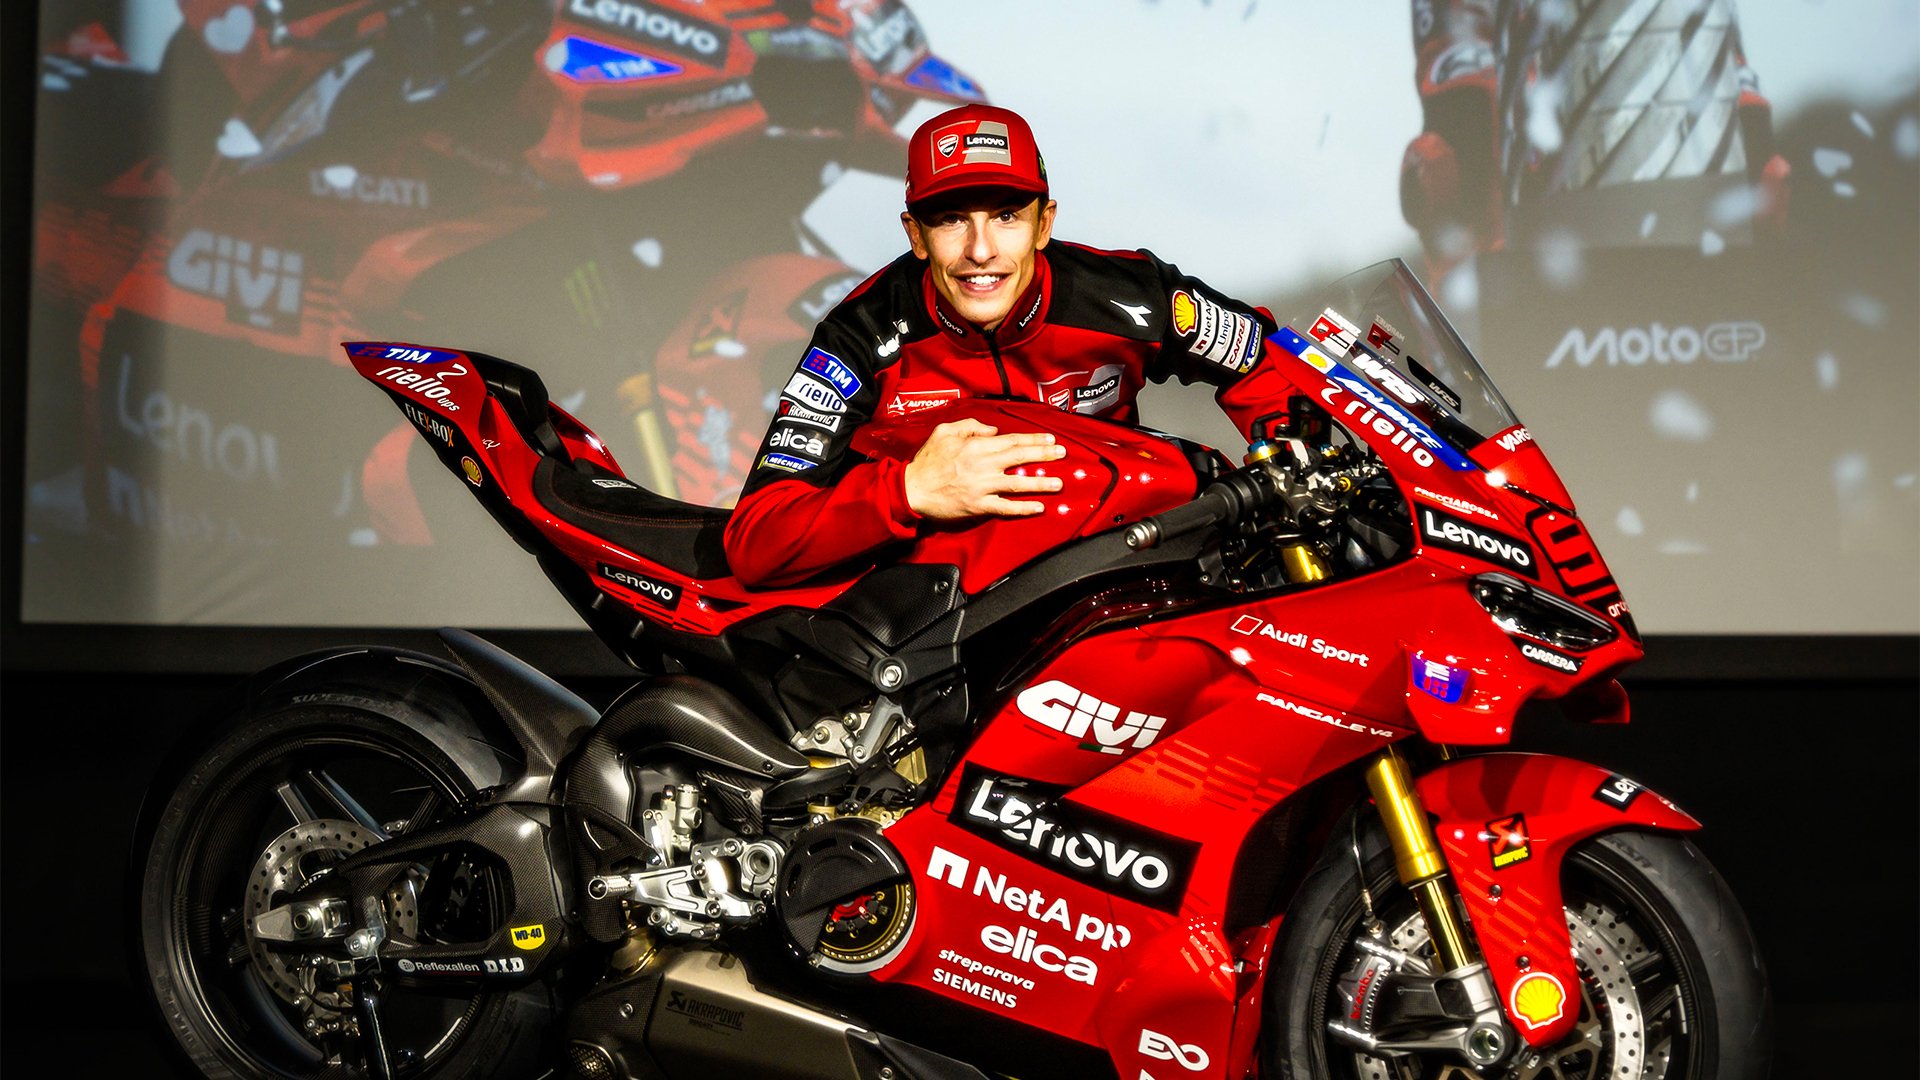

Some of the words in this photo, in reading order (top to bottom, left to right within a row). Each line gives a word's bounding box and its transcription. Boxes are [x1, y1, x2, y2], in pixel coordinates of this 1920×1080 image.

[571, 0, 719, 54] Lenovo
[966, 136, 1005, 146] Lenovo
[936, 305, 963, 334] Lenovo
[1019, 294, 1042, 327] Lenov
[1218, 312, 1231, 346] Unipo
[1545, 321, 1766, 368] MotoGP
[385, 348, 432, 363] TIM
[376, 366, 451, 399] riello
[437, 397, 460, 411] ups
[824, 360, 852, 389] TIM
[1077, 379, 1115, 398] Lenovo
[798, 383, 843, 411] riello
[117, 353, 281, 482] Leno
[405, 402, 454, 447] FLEX-BOX
[1344, 400, 1434, 467] riello
[769, 427, 824, 456] elica
[1496, 428, 1531, 452] VARG
[1424, 510, 1530, 567] Lenovo
[604, 566, 673, 600] Lenovo
[1259, 624, 1308, 648] Audi
[1310, 638, 1369, 667] Sport
[1522, 644, 1577, 672] CARRERA
[1256, 692, 1367, 732] PANIGALE
[1370, 727, 1393, 737] V4
[1600, 778, 1638, 803] Len
[968, 778, 1169, 888] Lenovo
[973, 866, 1131, 951] NetApp
[514, 928, 542, 941] WD-40
[415, 961, 480, 972] Reflexallen
[939, 949, 1035, 990] streparava
[980, 924, 1098, 986] elica
[932, 968, 1017, 1009] SIEMENS
